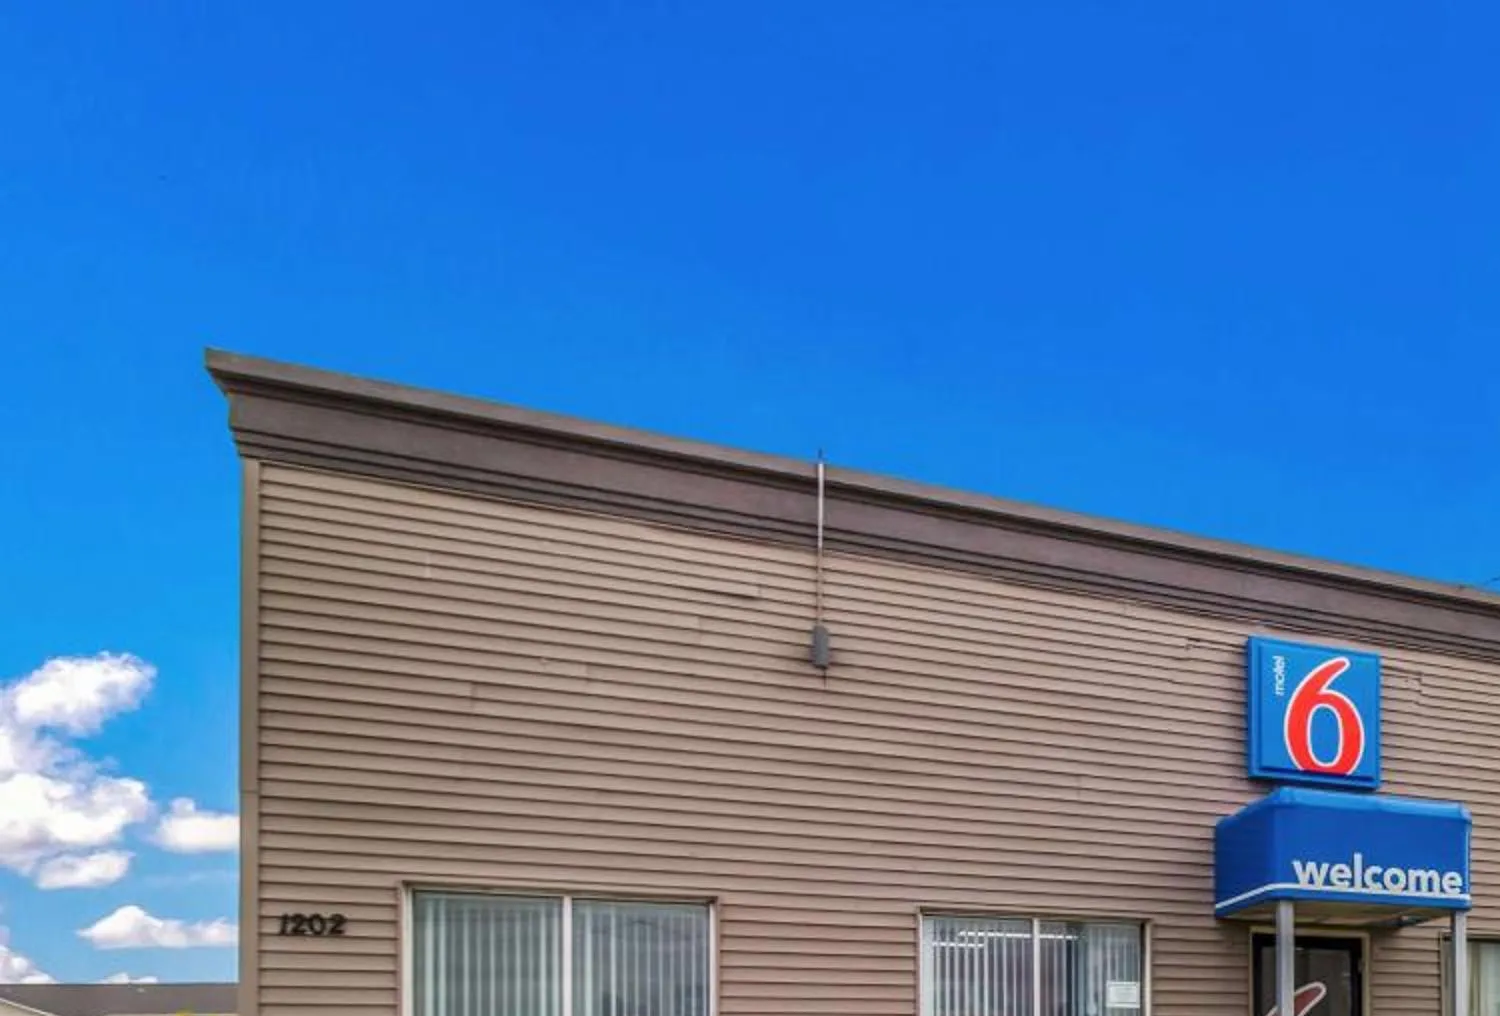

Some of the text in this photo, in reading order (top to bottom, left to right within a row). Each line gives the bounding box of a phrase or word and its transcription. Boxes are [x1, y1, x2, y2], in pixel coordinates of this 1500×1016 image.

[1271, 655, 1365, 776] motel 6
[1292, 852, 1463, 895] welcome
[280, 913, 346, 934] 1202
